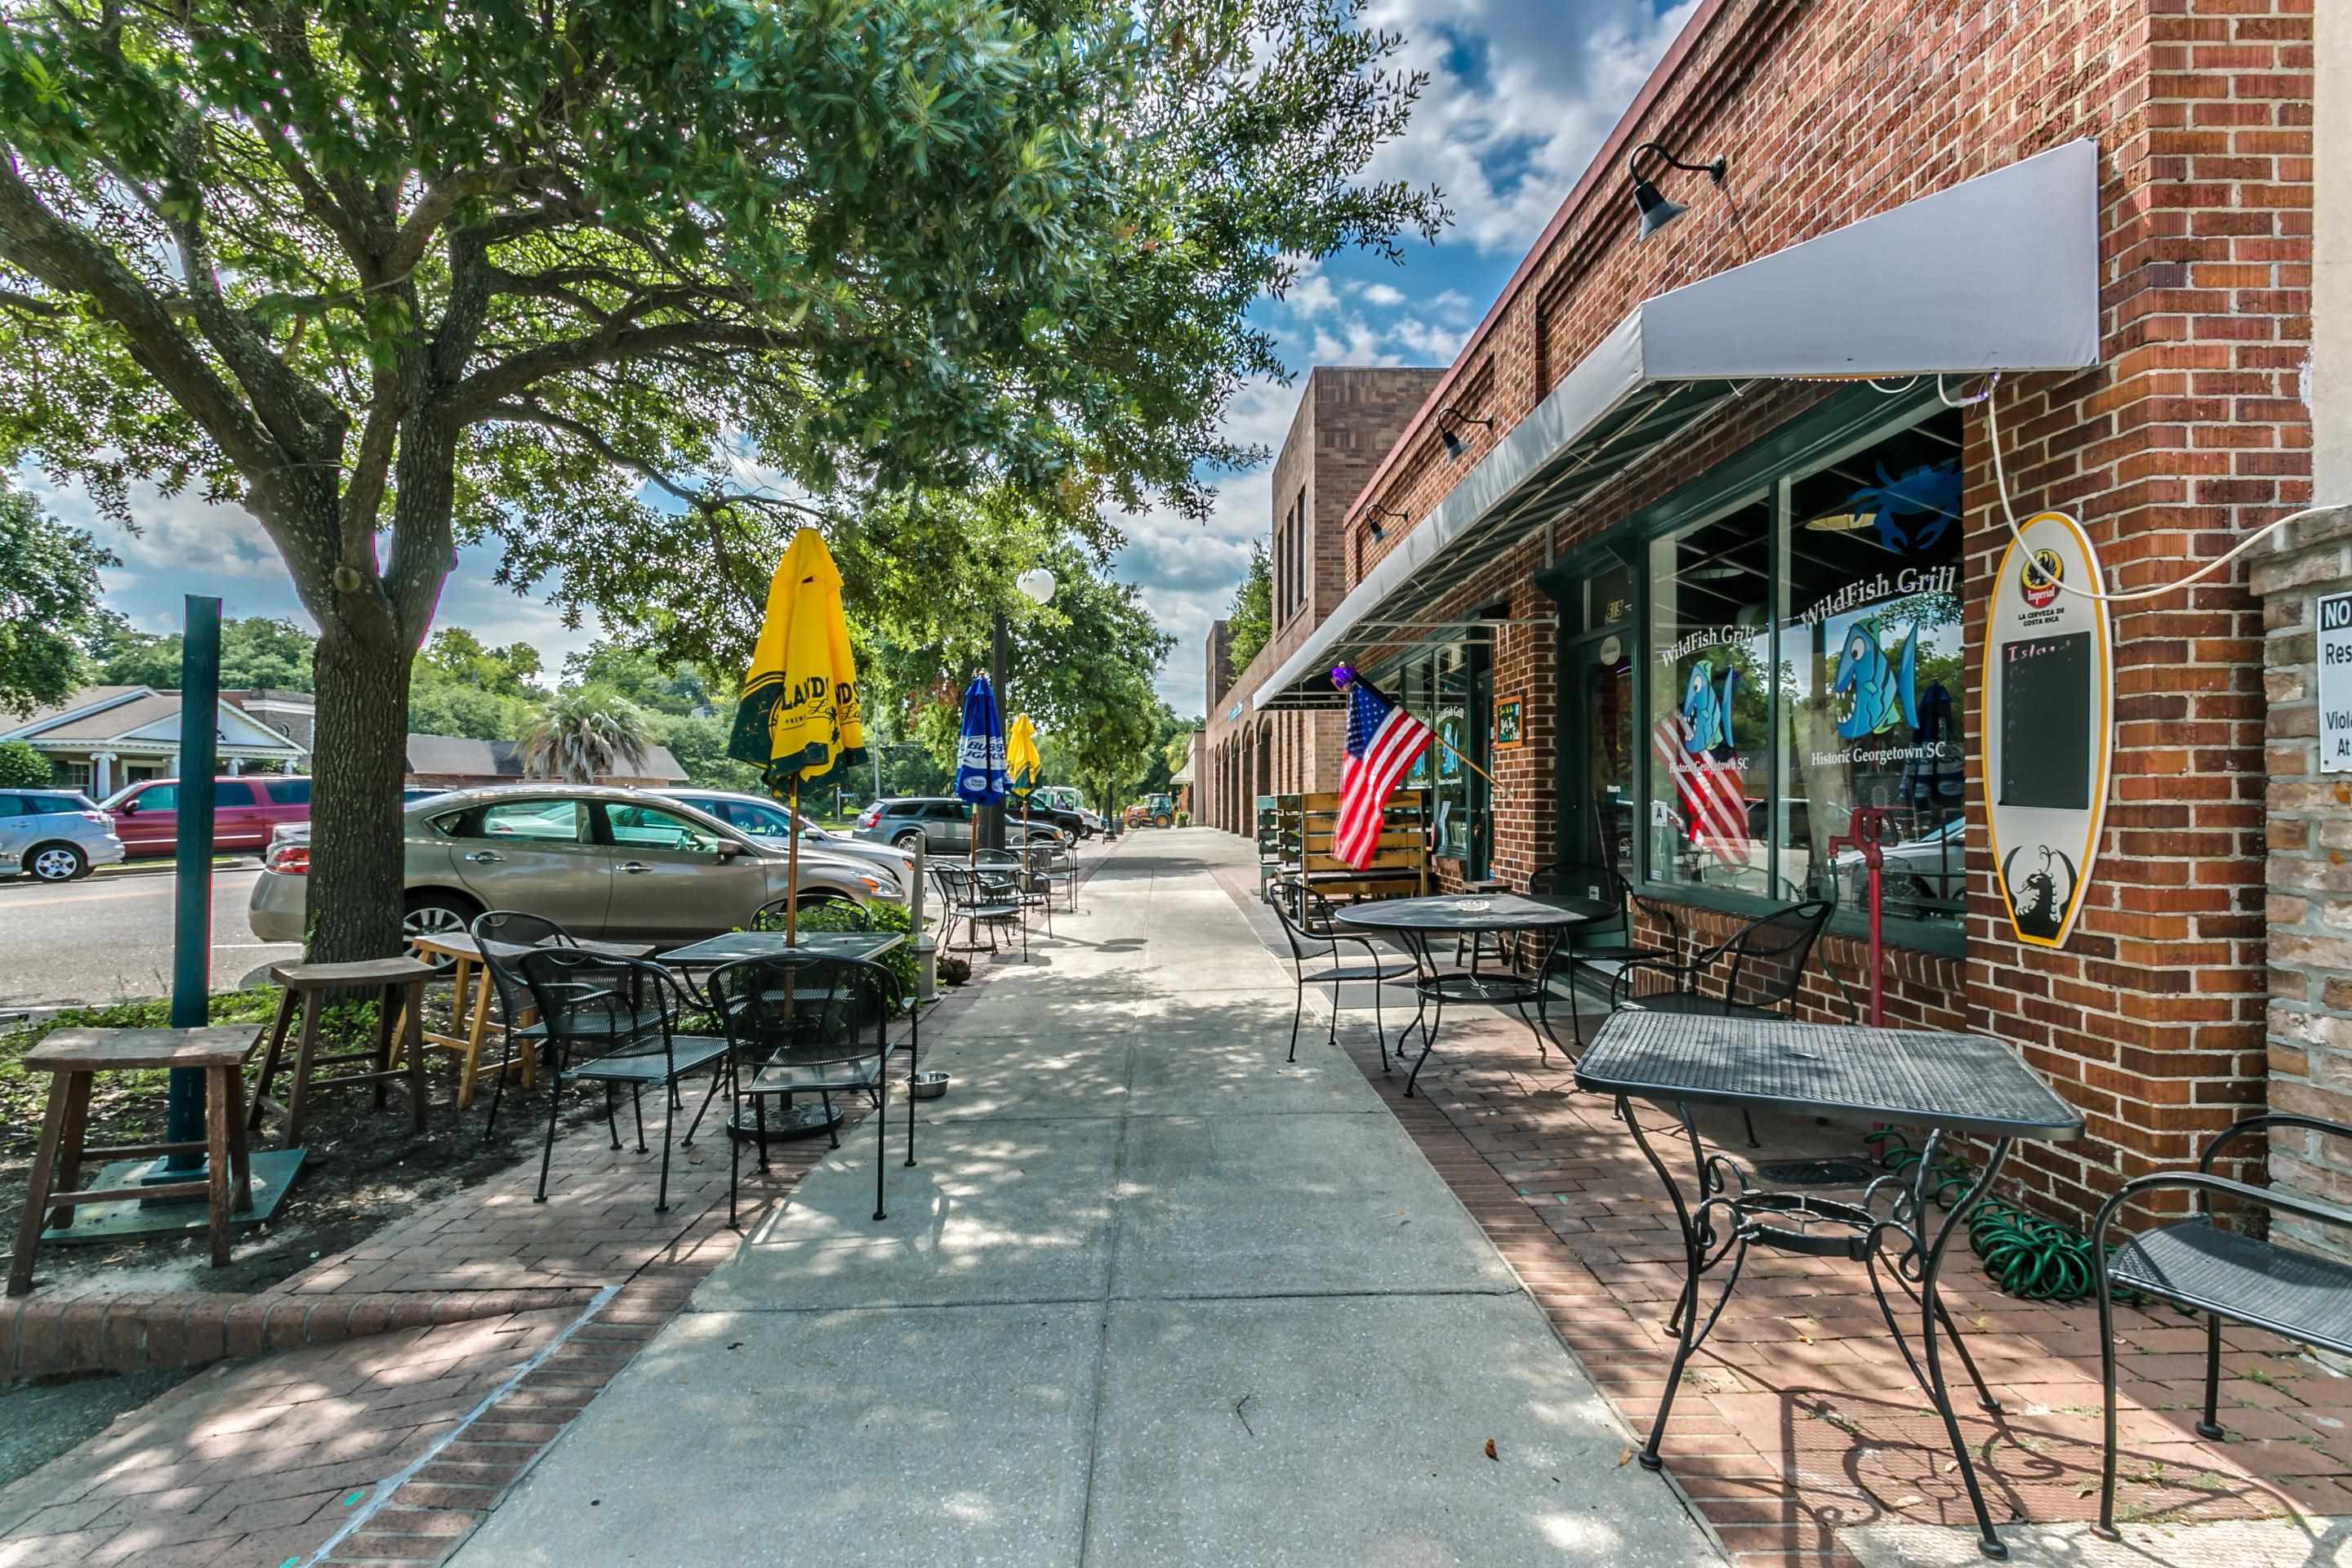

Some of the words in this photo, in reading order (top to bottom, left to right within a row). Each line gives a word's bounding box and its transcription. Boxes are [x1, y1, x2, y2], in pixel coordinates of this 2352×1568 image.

[1800, 573, 1890, 630] WildFish
[1897, 566, 1956, 595] Grill
[2024, 618, 2042, 626] COSTA
[2326, 600, 2350, 627] NO
[1662, 627, 1717, 667] WildFish
[1722, 625, 1756, 644] Grill
[1811, 751, 1851, 766] Historic
[1853, 746, 1923, 765] Georgetown
[1927, 742, 1945, 758] SC
[2337, 737, 2350, 756] At
[1737, 758, 1749, 770] SC
[1656, 807, 1663, 819] A
